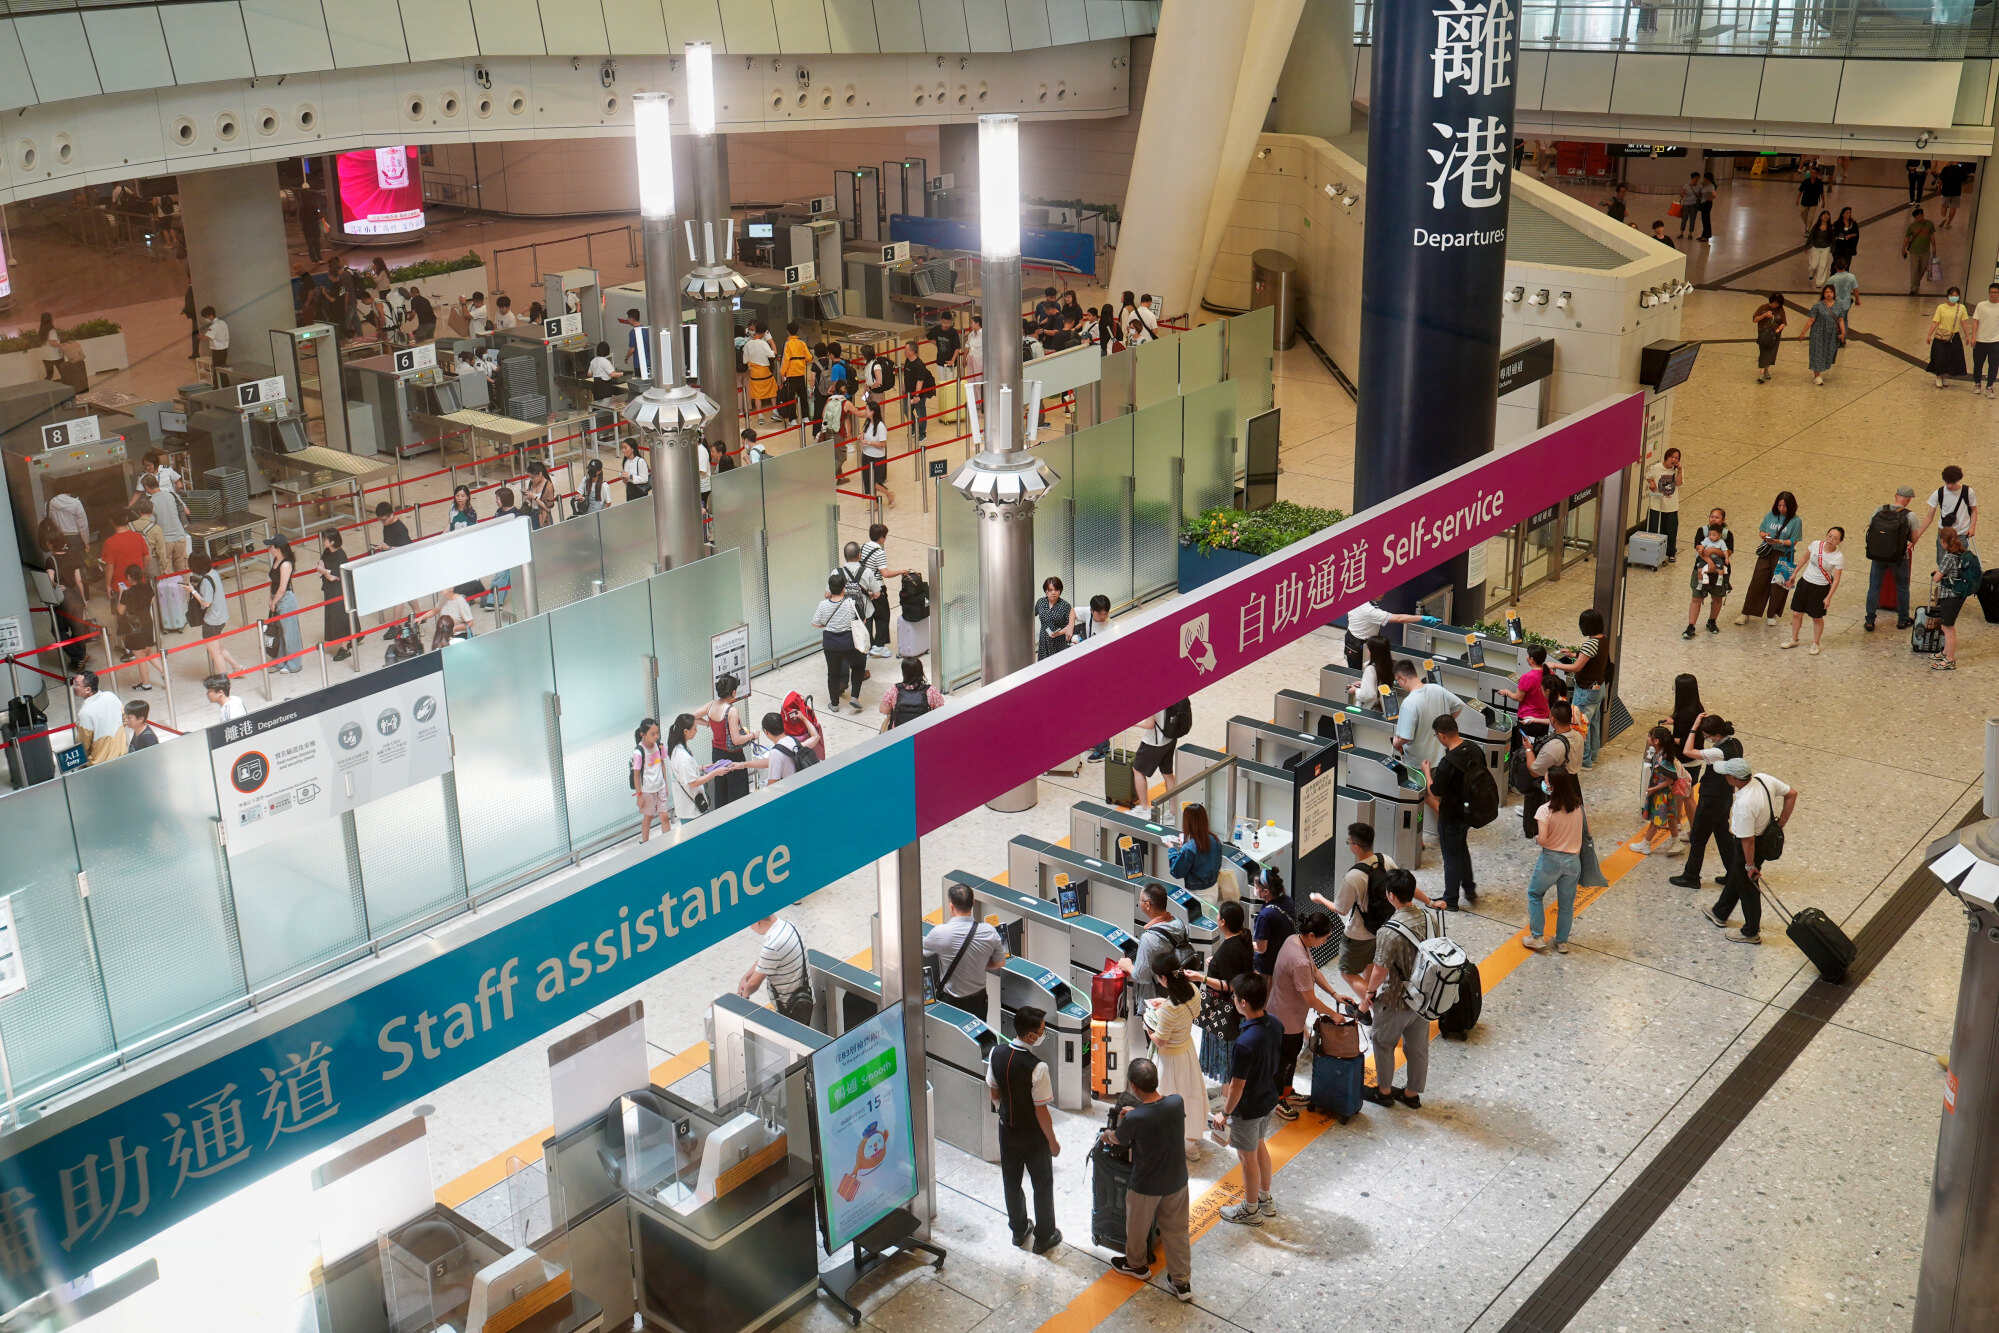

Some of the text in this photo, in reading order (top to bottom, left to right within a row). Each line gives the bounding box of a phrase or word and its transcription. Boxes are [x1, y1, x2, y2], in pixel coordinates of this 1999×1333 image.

[1427, 0, 1514, 209] 離港
[1413, 228, 1505, 251] Departures
[886, 249, 894, 260] 2
[789, 270, 796, 281] 3
[551, 322, 558, 334] 5
[401, 354, 409, 368] 6
[245, 388, 254, 401] 7
[52, 429, 63, 444] 8
[1381, 488, 1505, 575] Self-service
[1239, 538, 1369, 653] 自助通道
[257, 711, 298, 731] Departures
[224, 719, 254, 743] 離港
[65, 749, 80, 762] 入口
[66, 759, 80, 767] Entry
[377, 843, 791, 1081] Staff assistance
[866, 1094, 882, 1113] 15
[680, 1124, 687, 1135] 6
[435, 1264, 444, 1277] 5
